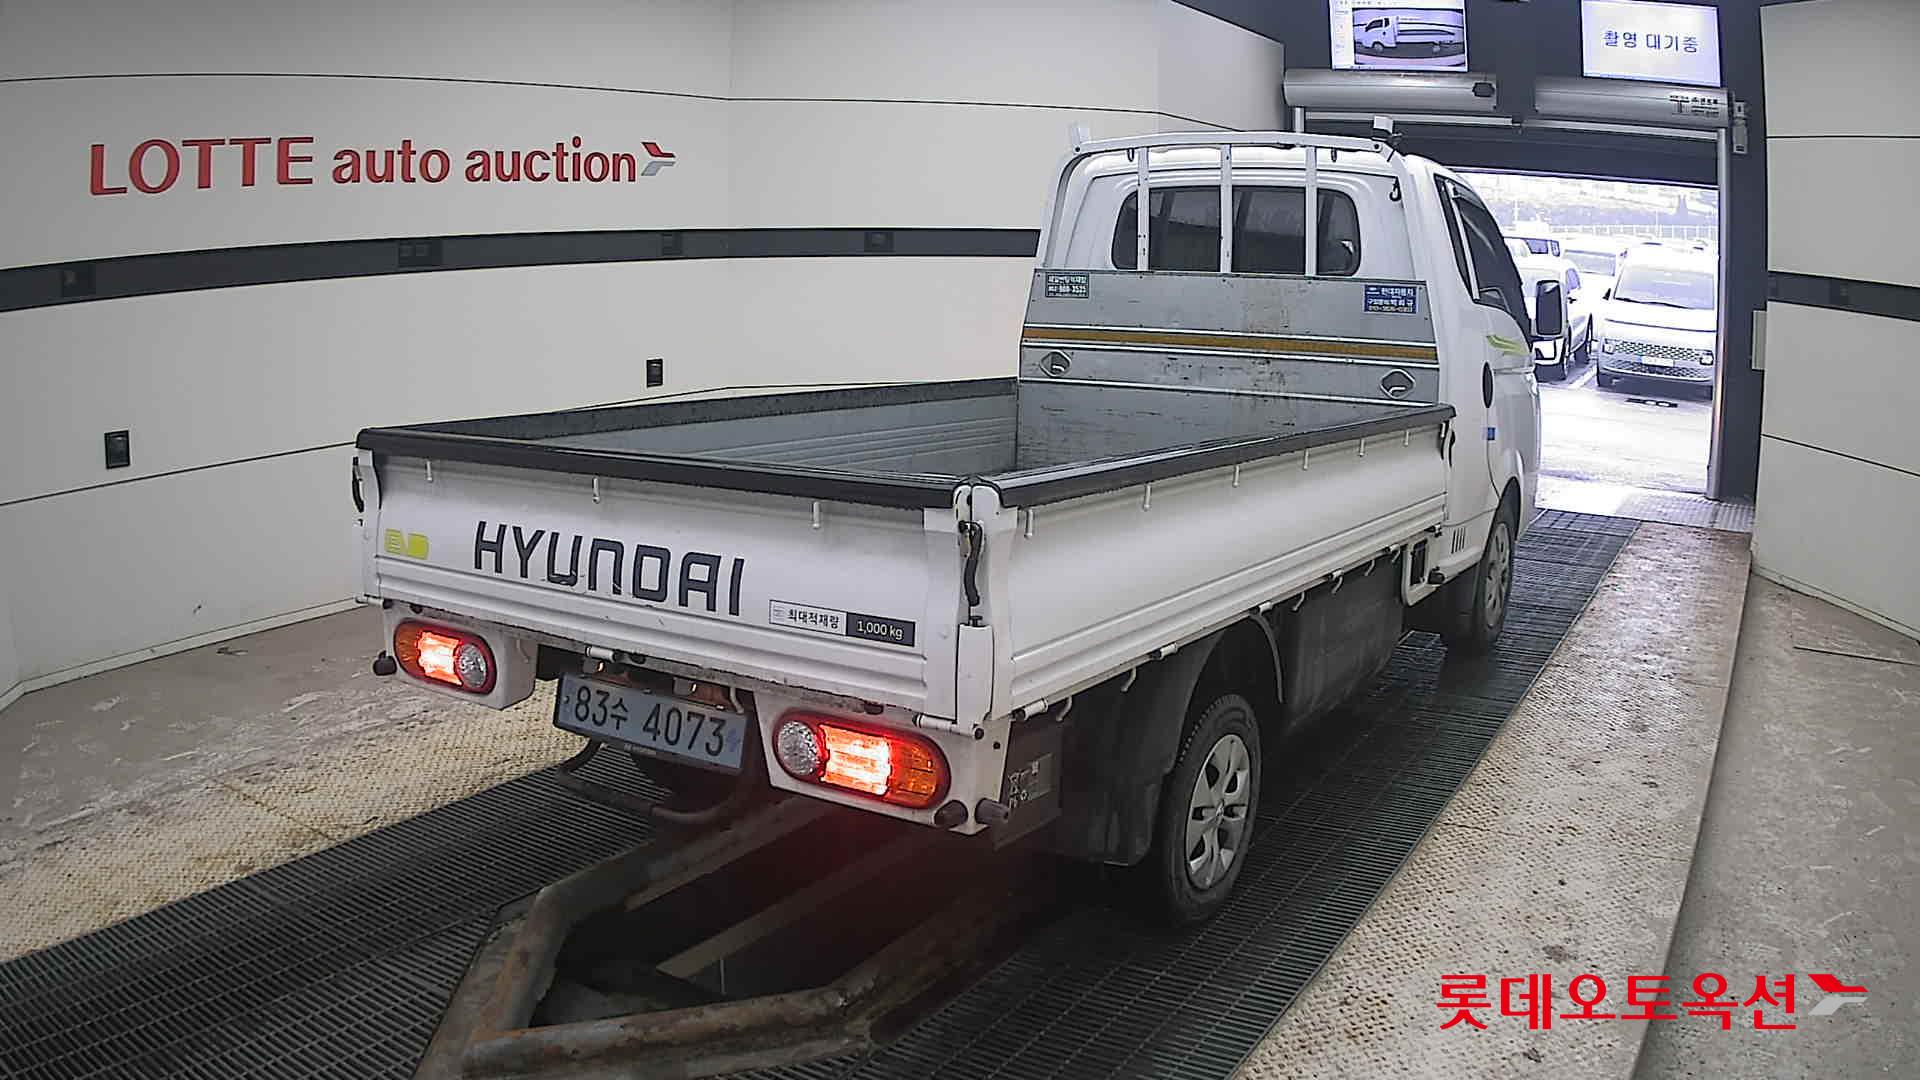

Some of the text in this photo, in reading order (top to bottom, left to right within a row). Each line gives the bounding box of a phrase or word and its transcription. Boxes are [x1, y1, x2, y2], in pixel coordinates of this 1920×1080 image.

[1603, 30, 1698, 53] 촬영 대기중
[90, 136, 636, 196] LOTTE auto auction
[473, 520, 745, 616] HYUNDAI
[788, 608, 904, 640] 최대적재량 1,000 kg
[574, 685, 727, 757] 83수 4073
